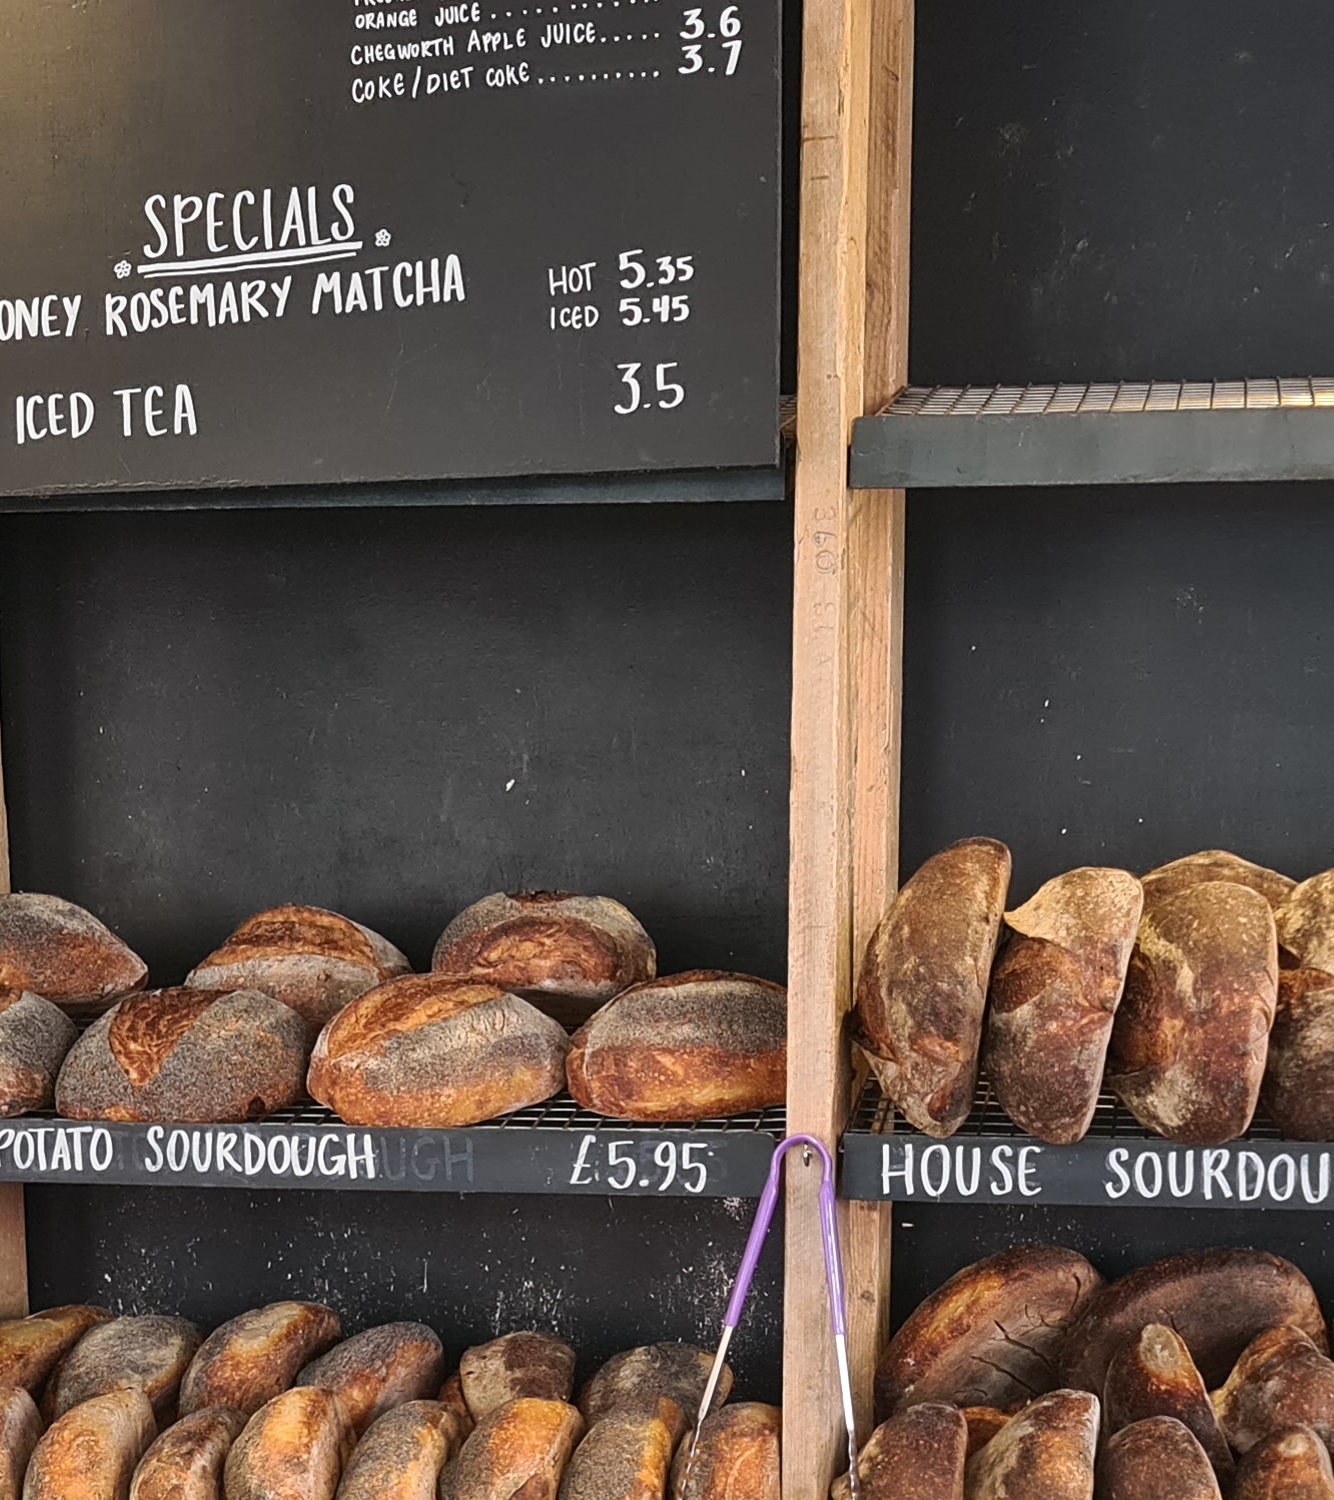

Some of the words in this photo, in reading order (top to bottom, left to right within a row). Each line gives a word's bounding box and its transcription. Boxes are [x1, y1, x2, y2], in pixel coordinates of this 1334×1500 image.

[351, 36, 454, 66] CHEGWORTH
[467, 29, 526, 53] APPLE
[541, 22, 596, 46] JUICE
[679, 6, 742, 40] 3.6
[355, 10, 417, 30] ORANGE
[435, 2, 481, 27] JUICE
[678, 40, 743, 76] 3.7
[143, 183, 356, 259] SPECIALS
[105, 275, 292, 336] ROSEMARY
[312, 254, 466, 315] MATCHA
[548, 262, 597, 296] HOT
[618, 249, 695, 290] 5.35
[550, 304, 599, 330] ICED
[621, 296, 690, 326] 5.45
[16, 391, 95, 444] ICED
[114, 384, 198, 437] TEA
[613, 362, 686, 414] 3.5
[144, 1128, 378, 1179] SOURDOUGH
[568, 1134, 710, 1194] £5.95
[880, 1144, 1043, 1198] HOUSE
